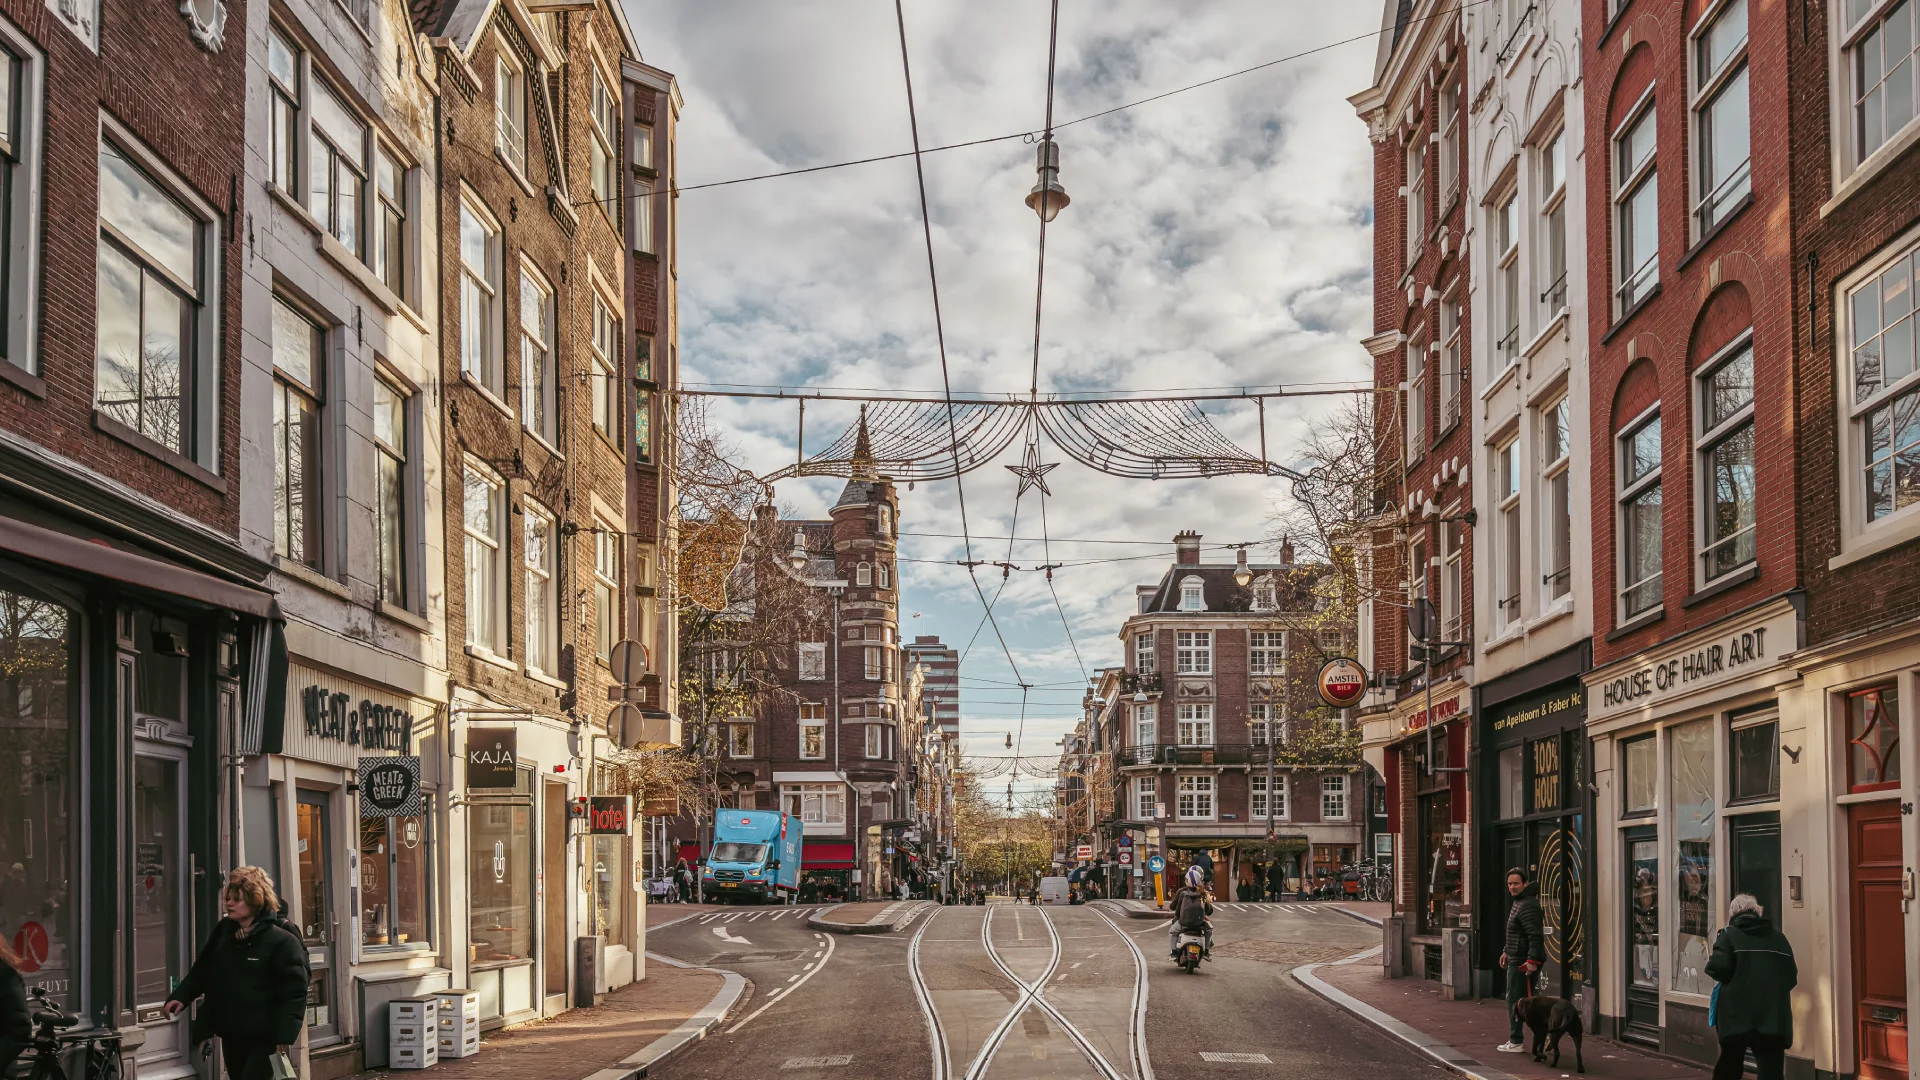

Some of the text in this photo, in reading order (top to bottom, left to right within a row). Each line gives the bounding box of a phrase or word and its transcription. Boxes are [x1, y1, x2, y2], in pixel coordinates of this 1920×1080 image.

[1328, 674, 1360, 684] AMSTEL
[1603, 626, 1767, 707] HOUSE OF HAIR ART
[304, 685, 414, 756] MEAT & GREEK
[1494, 718, 1506, 731] van
[1506, 708, 1540, 729] Apeldoorn
[1541, 703, 1547, 716] &
[1548, 698, 1570, 714] Faber
[470, 751, 513, 764] KAJA
[1534, 738, 1559, 775] 100%
[372, 785, 406, 800] GREEK
[1534, 774, 1559, 809] HOUT
[591, 803, 627, 830] hotel
